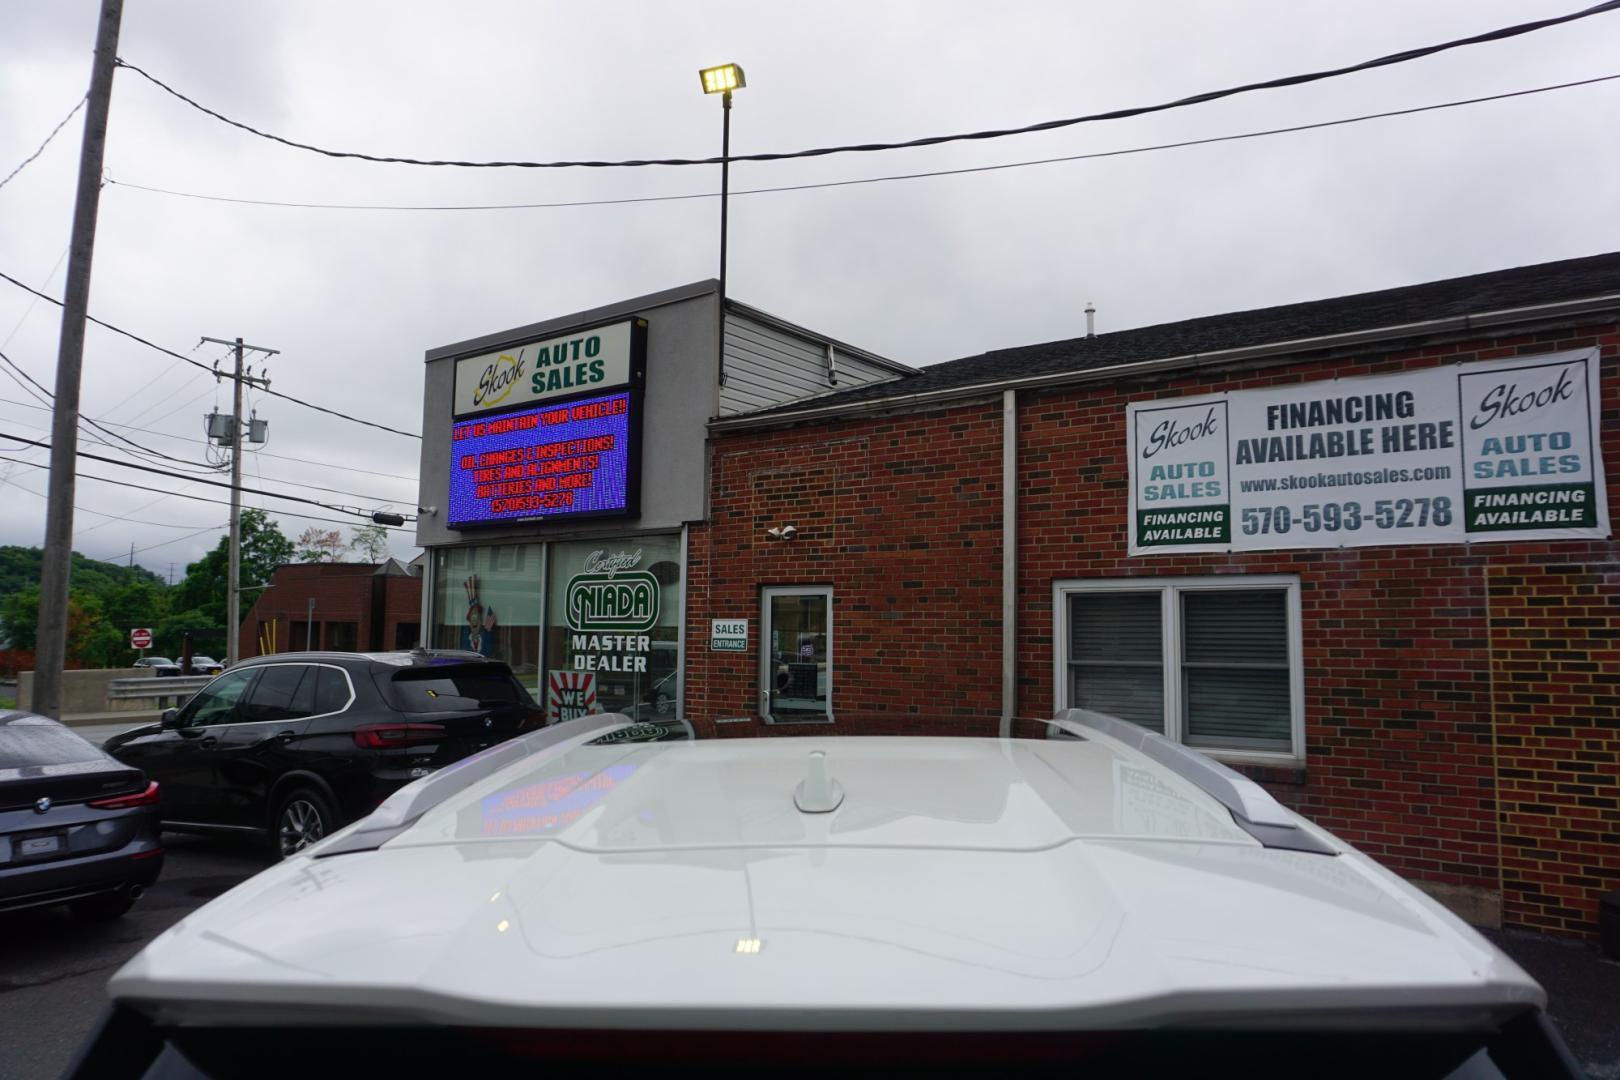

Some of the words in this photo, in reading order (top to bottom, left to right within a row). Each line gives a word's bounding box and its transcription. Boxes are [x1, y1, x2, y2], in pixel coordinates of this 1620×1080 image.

[536, 335, 601, 369] AUTO
[473, 349, 526, 406] Skook
[532, 359, 605, 395] SALES
[1266, 390, 1415, 431] FINANCING
[1469, 368, 1575, 431] Skook
[453, 425, 470, 441] LET
[474, 422, 485, 437] US
[488, 414, 538, 434] MAINTAIN
[541, 408, 568, 426] YOUR
[572, 399, 626, 420] VEHICLE!!
[1142, 407, 1218, 459] Skook
[461, 454, 477, 469] OIL
[479, 448, 524, 467] CHANGES
[535, 434, 614, 460] INSPECTIONS!
[1235, 429, 1375, 465] AVAILABLE
[1382, 420, 1455, 454] HERE
[1480, 431, 1572, 457] AUTO
[473, 466, 502, 482] TIRES
[504, 462, 525, 478] AND
[527, 454, 599, 476] ALIGNMENTS!
[1149, 461, 1216, 482] AUTO
[1240, 464, 1452, 494] www.skookautosales.com
[1473, 454, 1582, 480] SALES
[477, 479, 532, 498] BATTERIES
[534, 476, 556, 491] AND
[559, 472, 593, 488] MORE!
[1143, 480, 1222, 502] SALES
[1473, 489, 1586, 509] FINANCING
[1143, 509, 1224, 527] FINANCING
[1241, 496, 1454, 536] 570-593-5278
[1473, 507, 1584, 526] AVAILABLE
[1143, 526, 1223, 542] AVAILABLE
[584, 547, 642, 579] Certified
[573, 584, 651, 619] NIADA
[715, 624, 745, 635] SALES
[572, 634, 650, 652] MASTER
[713, 639, 746, 649] ENTRANCE
[574, 654, 647, 672] DEALER
[560, 690, 585, 707] WE
[559, 707, 588, 722] BUY
